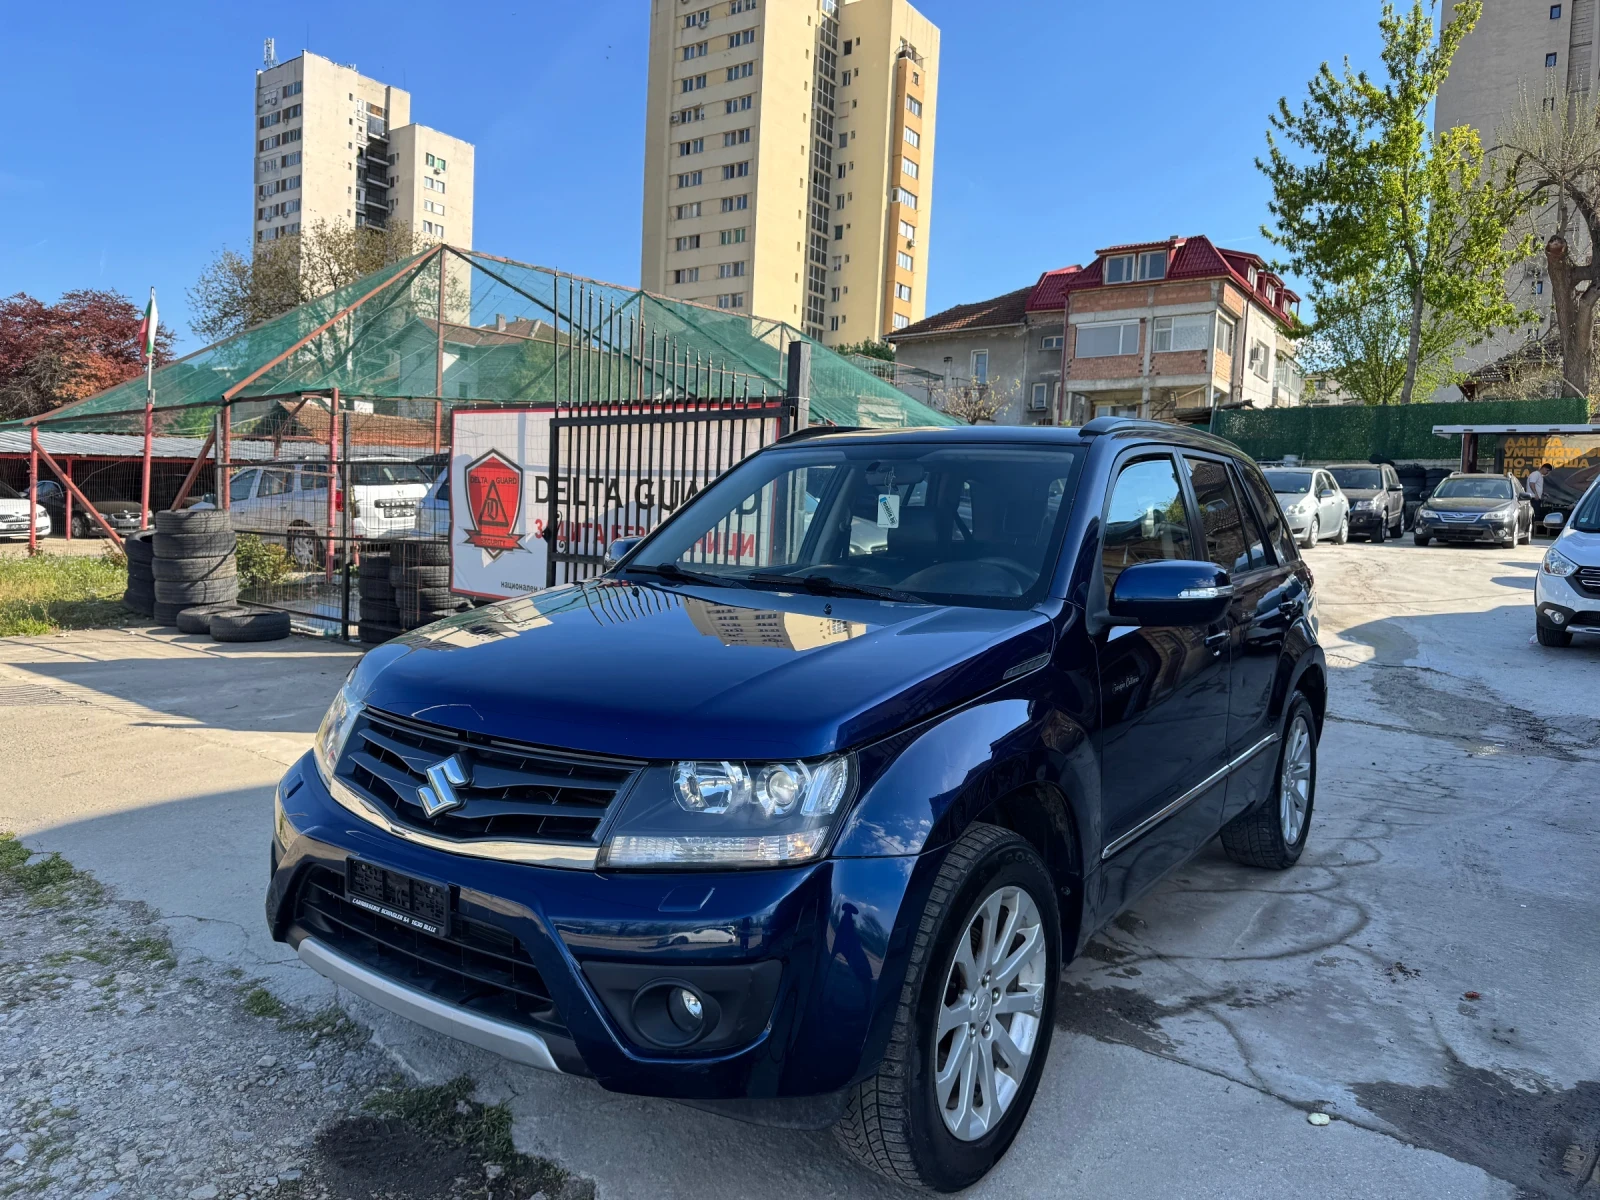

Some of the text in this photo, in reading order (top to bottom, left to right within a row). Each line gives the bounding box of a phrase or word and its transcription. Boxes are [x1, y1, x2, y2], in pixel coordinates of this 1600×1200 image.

[1504, 436, 1563, 447] ДАЙ НА
[1504, 447, 1582, 457] УМЕНИЯТА
[1504, 458, 1590, 468] ПО-ВИСША
[469, 475, 518, 485] DELTA GUARD
[535, 475, 624, 508] DELTA
[480, 537, 506, 547] SECURITY
